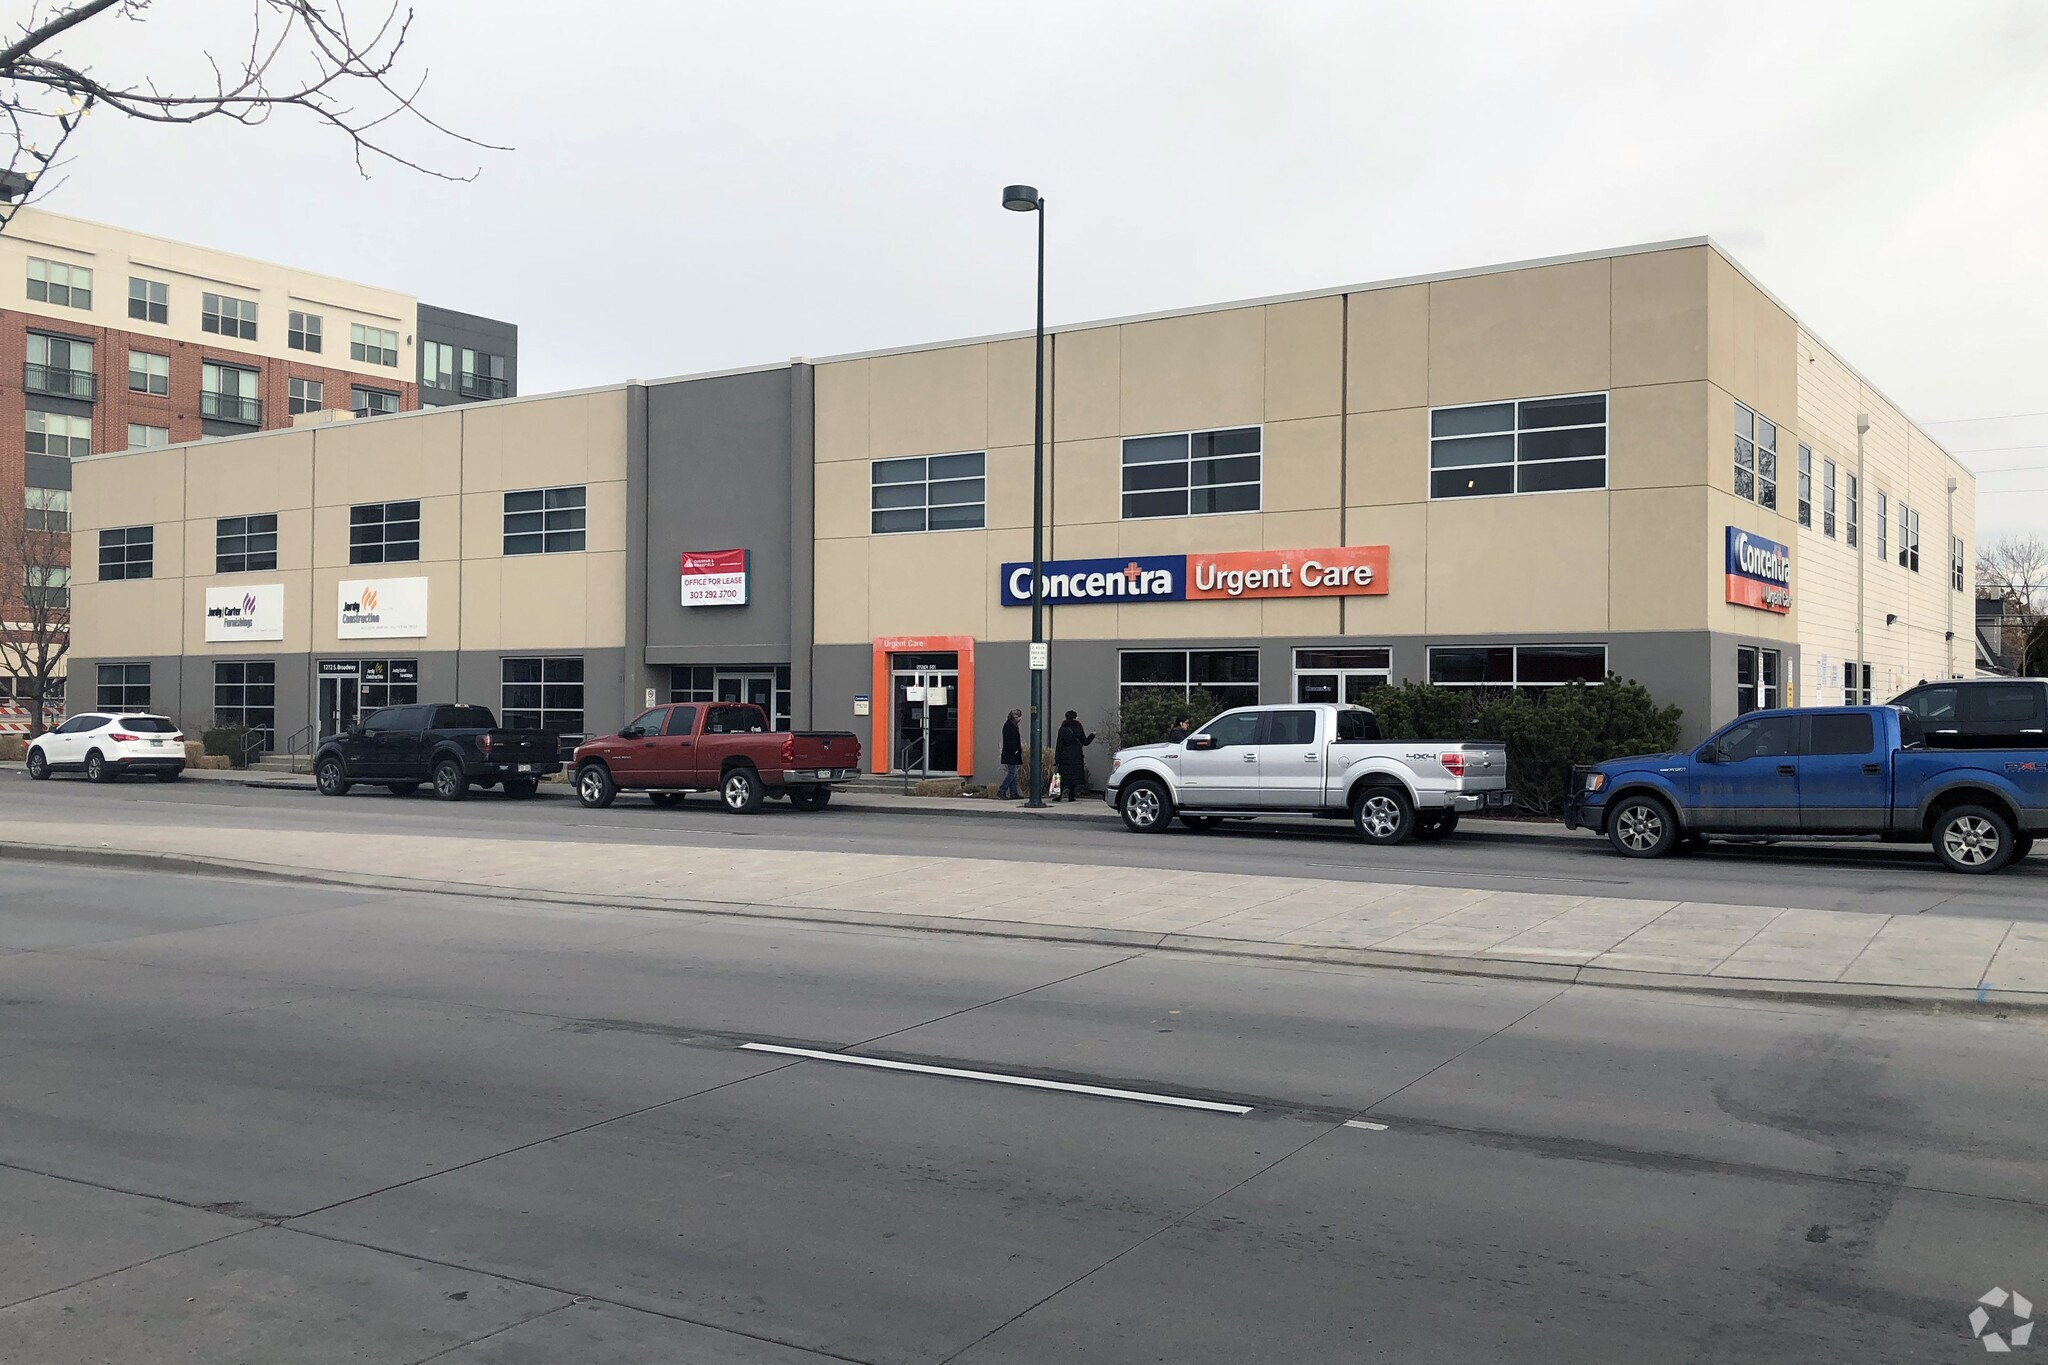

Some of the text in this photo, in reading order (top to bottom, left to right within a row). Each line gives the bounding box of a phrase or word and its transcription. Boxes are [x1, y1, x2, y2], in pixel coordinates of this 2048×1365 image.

[1737, 532, 1790, 582] Concentra
[1009, 560, 1373, 599] Concentra Urgent Care
[690, 590, 737, 599] 303 292 3700
[343, 601, 360, 613] Jordy
[342, 613, 380, 624] Construction
[884, 639, 924, 648] Urgent Care
